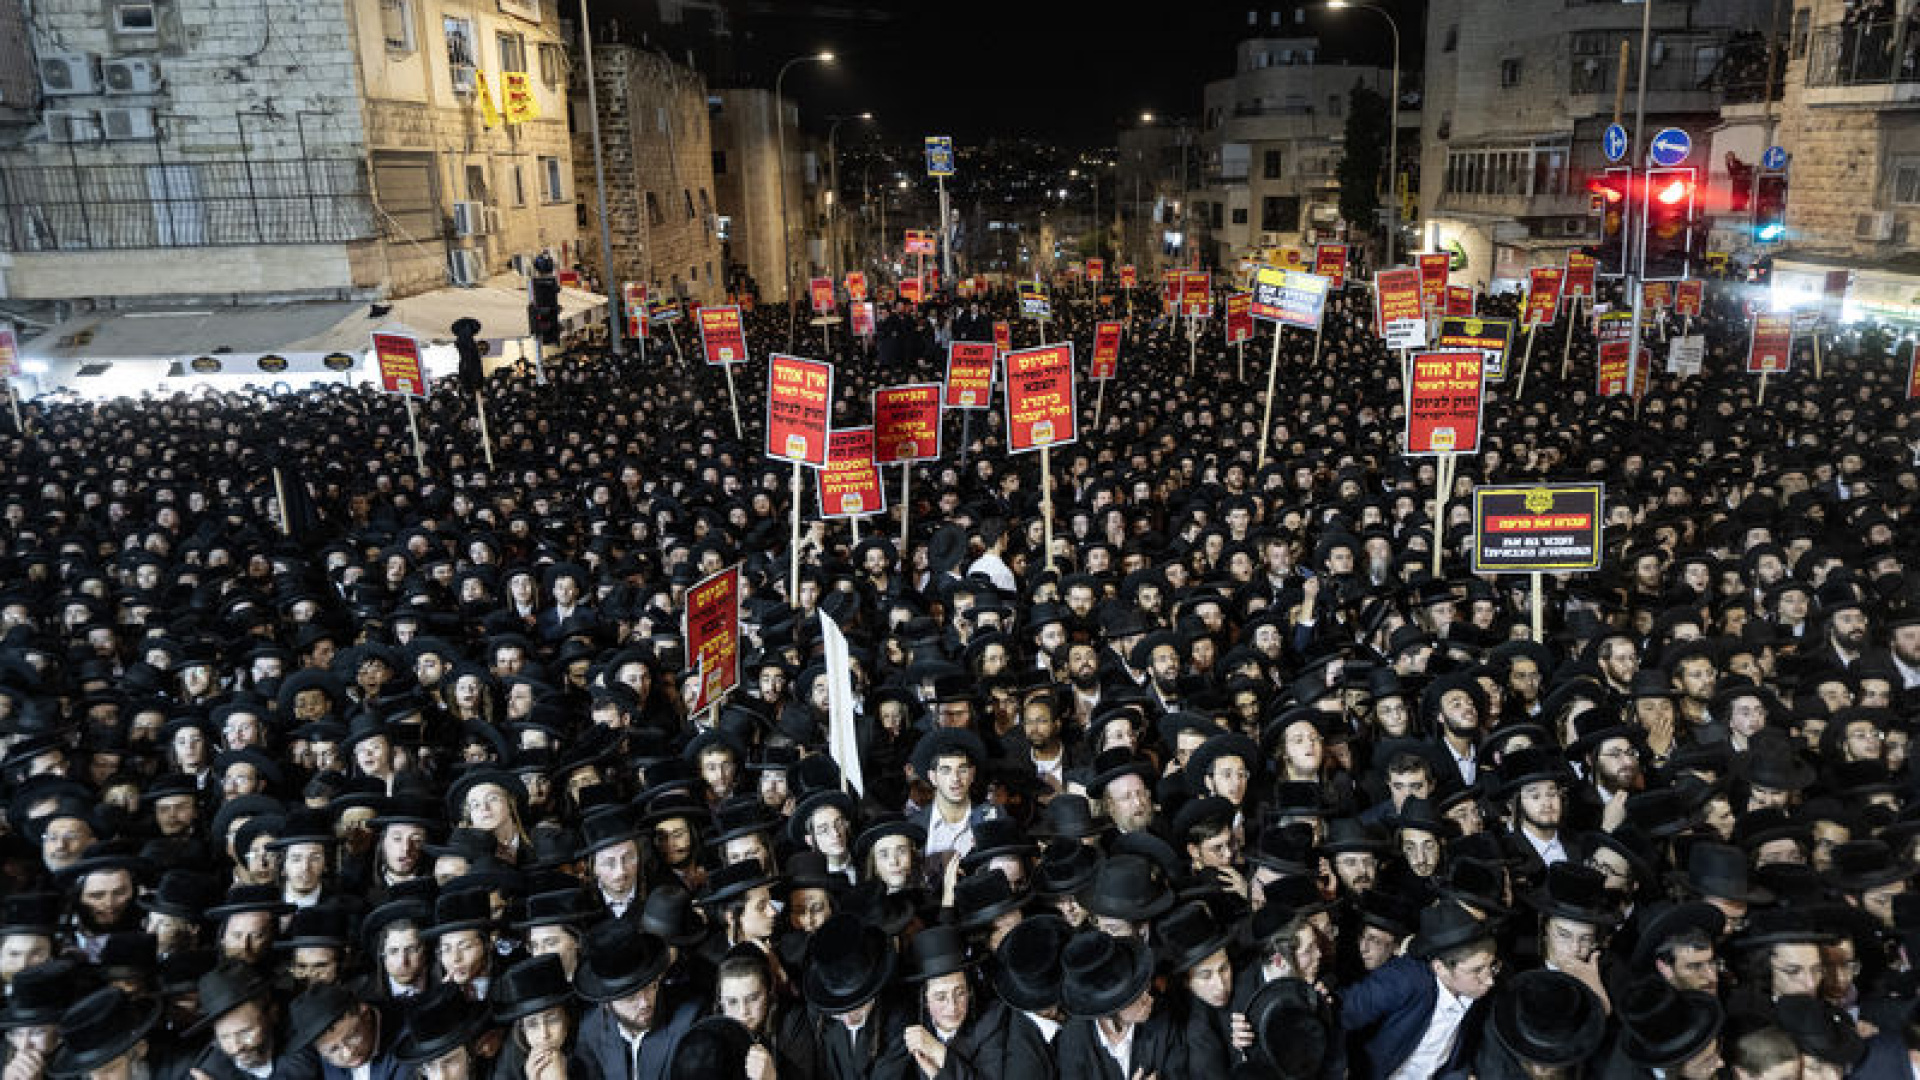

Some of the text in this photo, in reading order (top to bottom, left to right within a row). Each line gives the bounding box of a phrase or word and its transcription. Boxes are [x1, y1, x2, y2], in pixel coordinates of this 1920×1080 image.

[773, 364, 827, 388] אין אחד
[1417, 361, 1452, 378] אחד
[1455, 361, 1480, 379] אין
[1453, 395, 1477, 410] חוק
